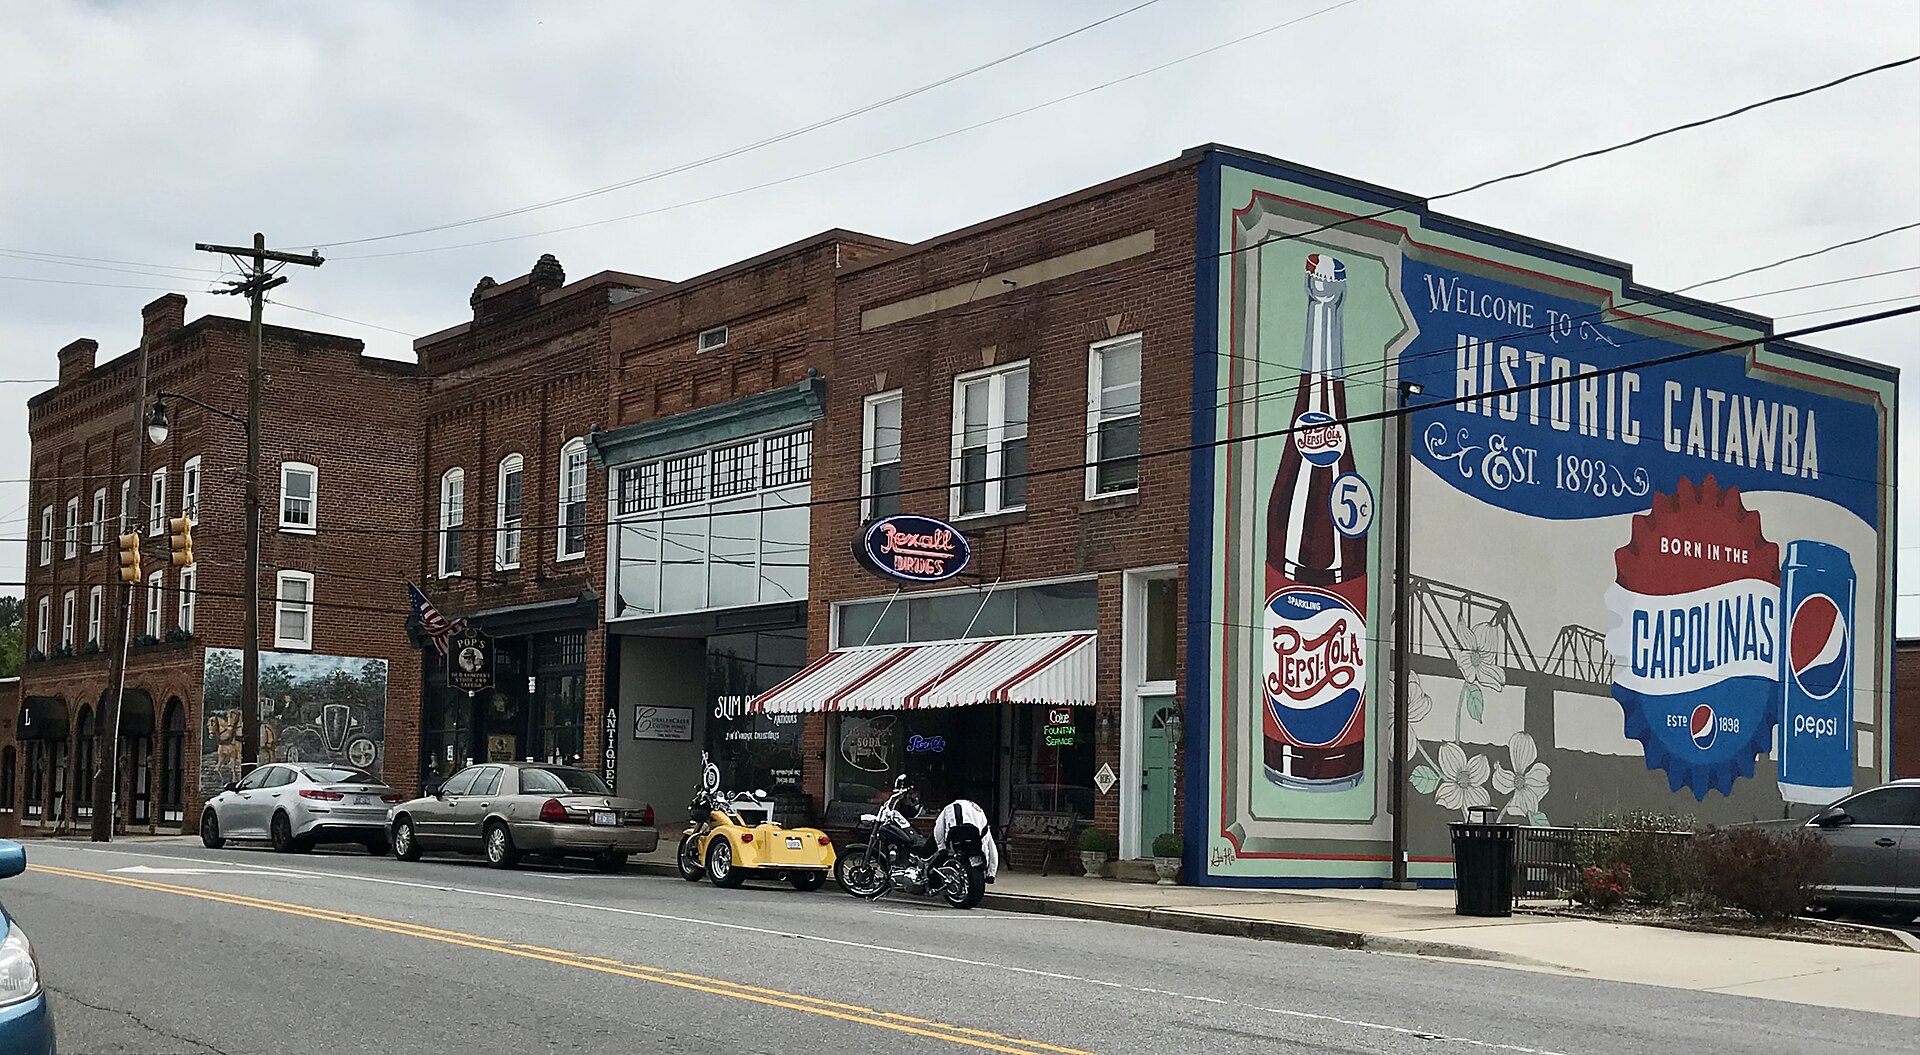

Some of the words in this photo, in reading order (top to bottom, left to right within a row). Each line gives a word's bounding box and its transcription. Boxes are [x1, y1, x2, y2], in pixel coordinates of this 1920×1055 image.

[1424, 273, 1534, 329] WELCOME
[1546, 309, 1572, 344] TO
[1455, 333, 1641, 446] HISTORIC
[1664, 379, 1820, 480] CATAWBA
[1481, 433, 1541, 491] EST.
[1555, 453, 1609, 498] 1893
[880, 523, 955, 555] Rexall
[1660, 537, 1702, 559] BORN
[1707, 546, 1720, 562] IN
[1724, 547, 1749, 564] THE
[894, 555, 944, 576] DRUGS
[1287, 595, 1321, 611] SPARKLING
[457, 639, 486, 649] POP'S
[1631, 593, 1774, 679] CAROLINAS
[714, 695, 741, 721] SLIM
[1049, 709, 1070, 724] Coke
[1719, 717, 1740, 734] 1898
[1794, 714, 1837, 737] pepsi
[605, 708, 617, 789] ANTIQUES
[857, 737, 881, 747] SODA
[1045, 736, 1074, 746] SERVICE
